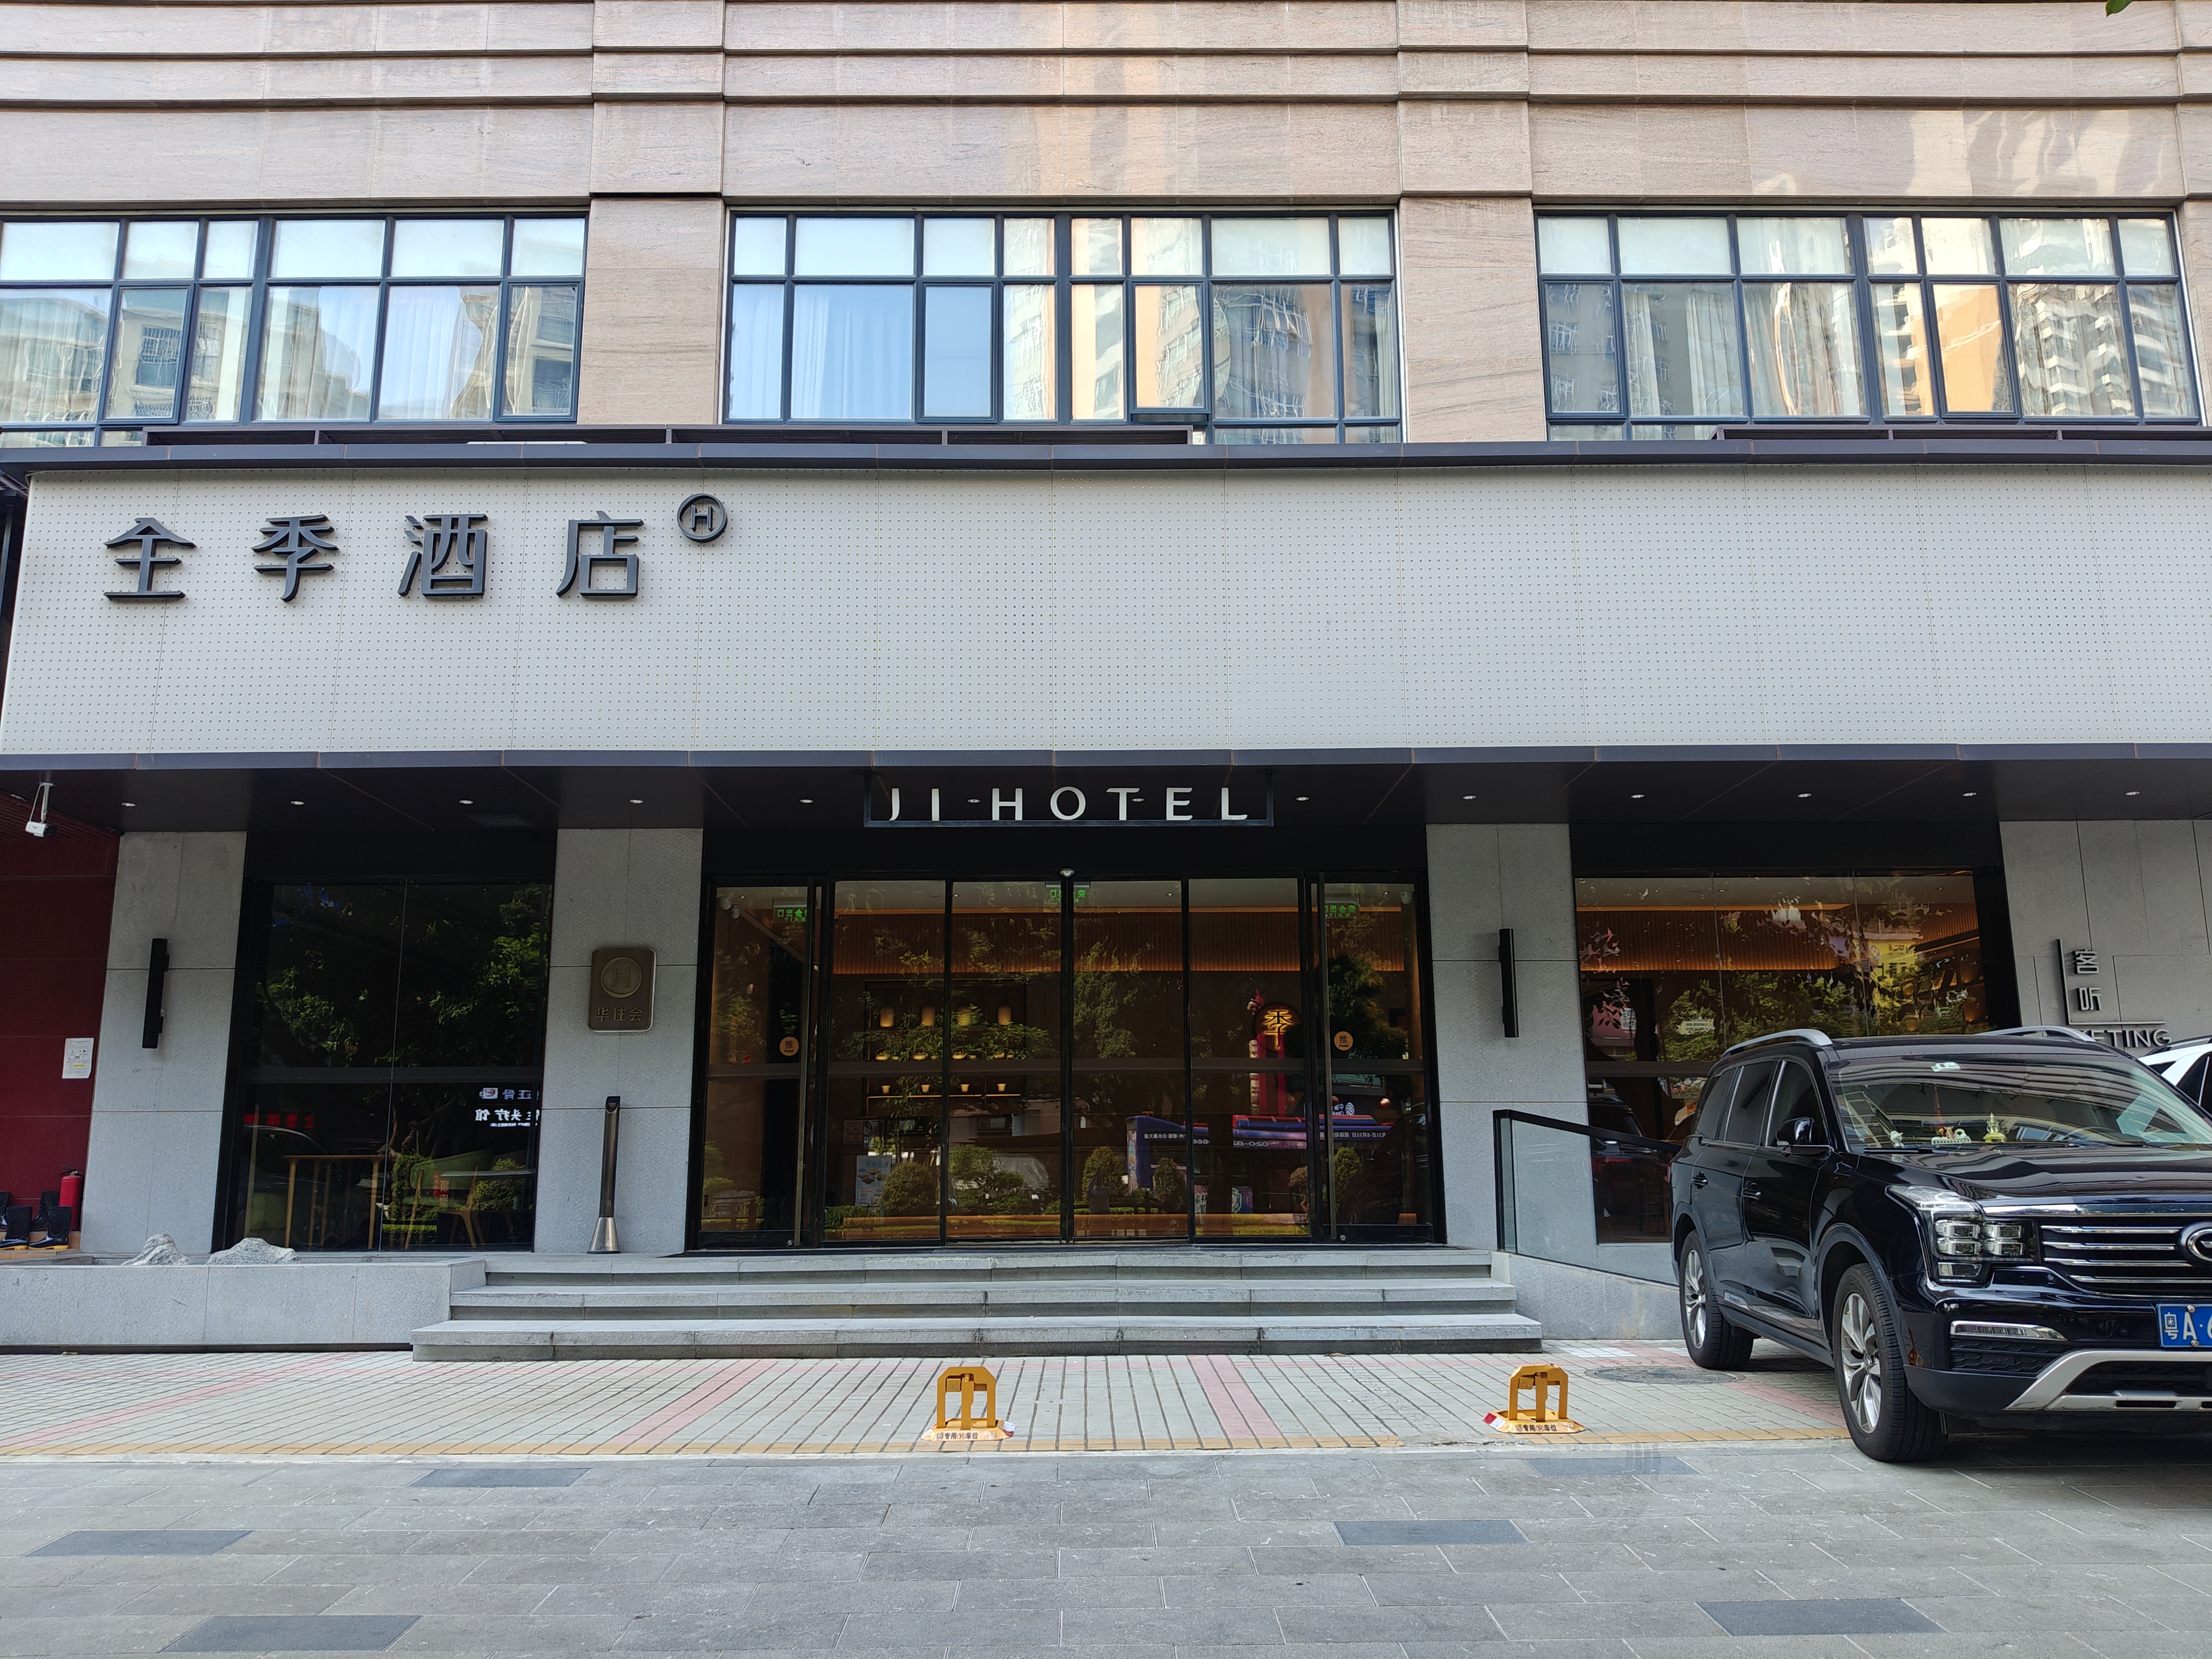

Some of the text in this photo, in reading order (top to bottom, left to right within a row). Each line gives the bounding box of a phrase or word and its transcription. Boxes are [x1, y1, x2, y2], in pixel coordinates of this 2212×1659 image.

[103, 510, 645, 603] 全季酒店
[889, 786, 1248, 821] JI HOTEL
[785, 1040, 794, 1049] 推
[1339, 1035, 1348, 1043] 推
[2080, 1029, 2172, 1047] ETING
